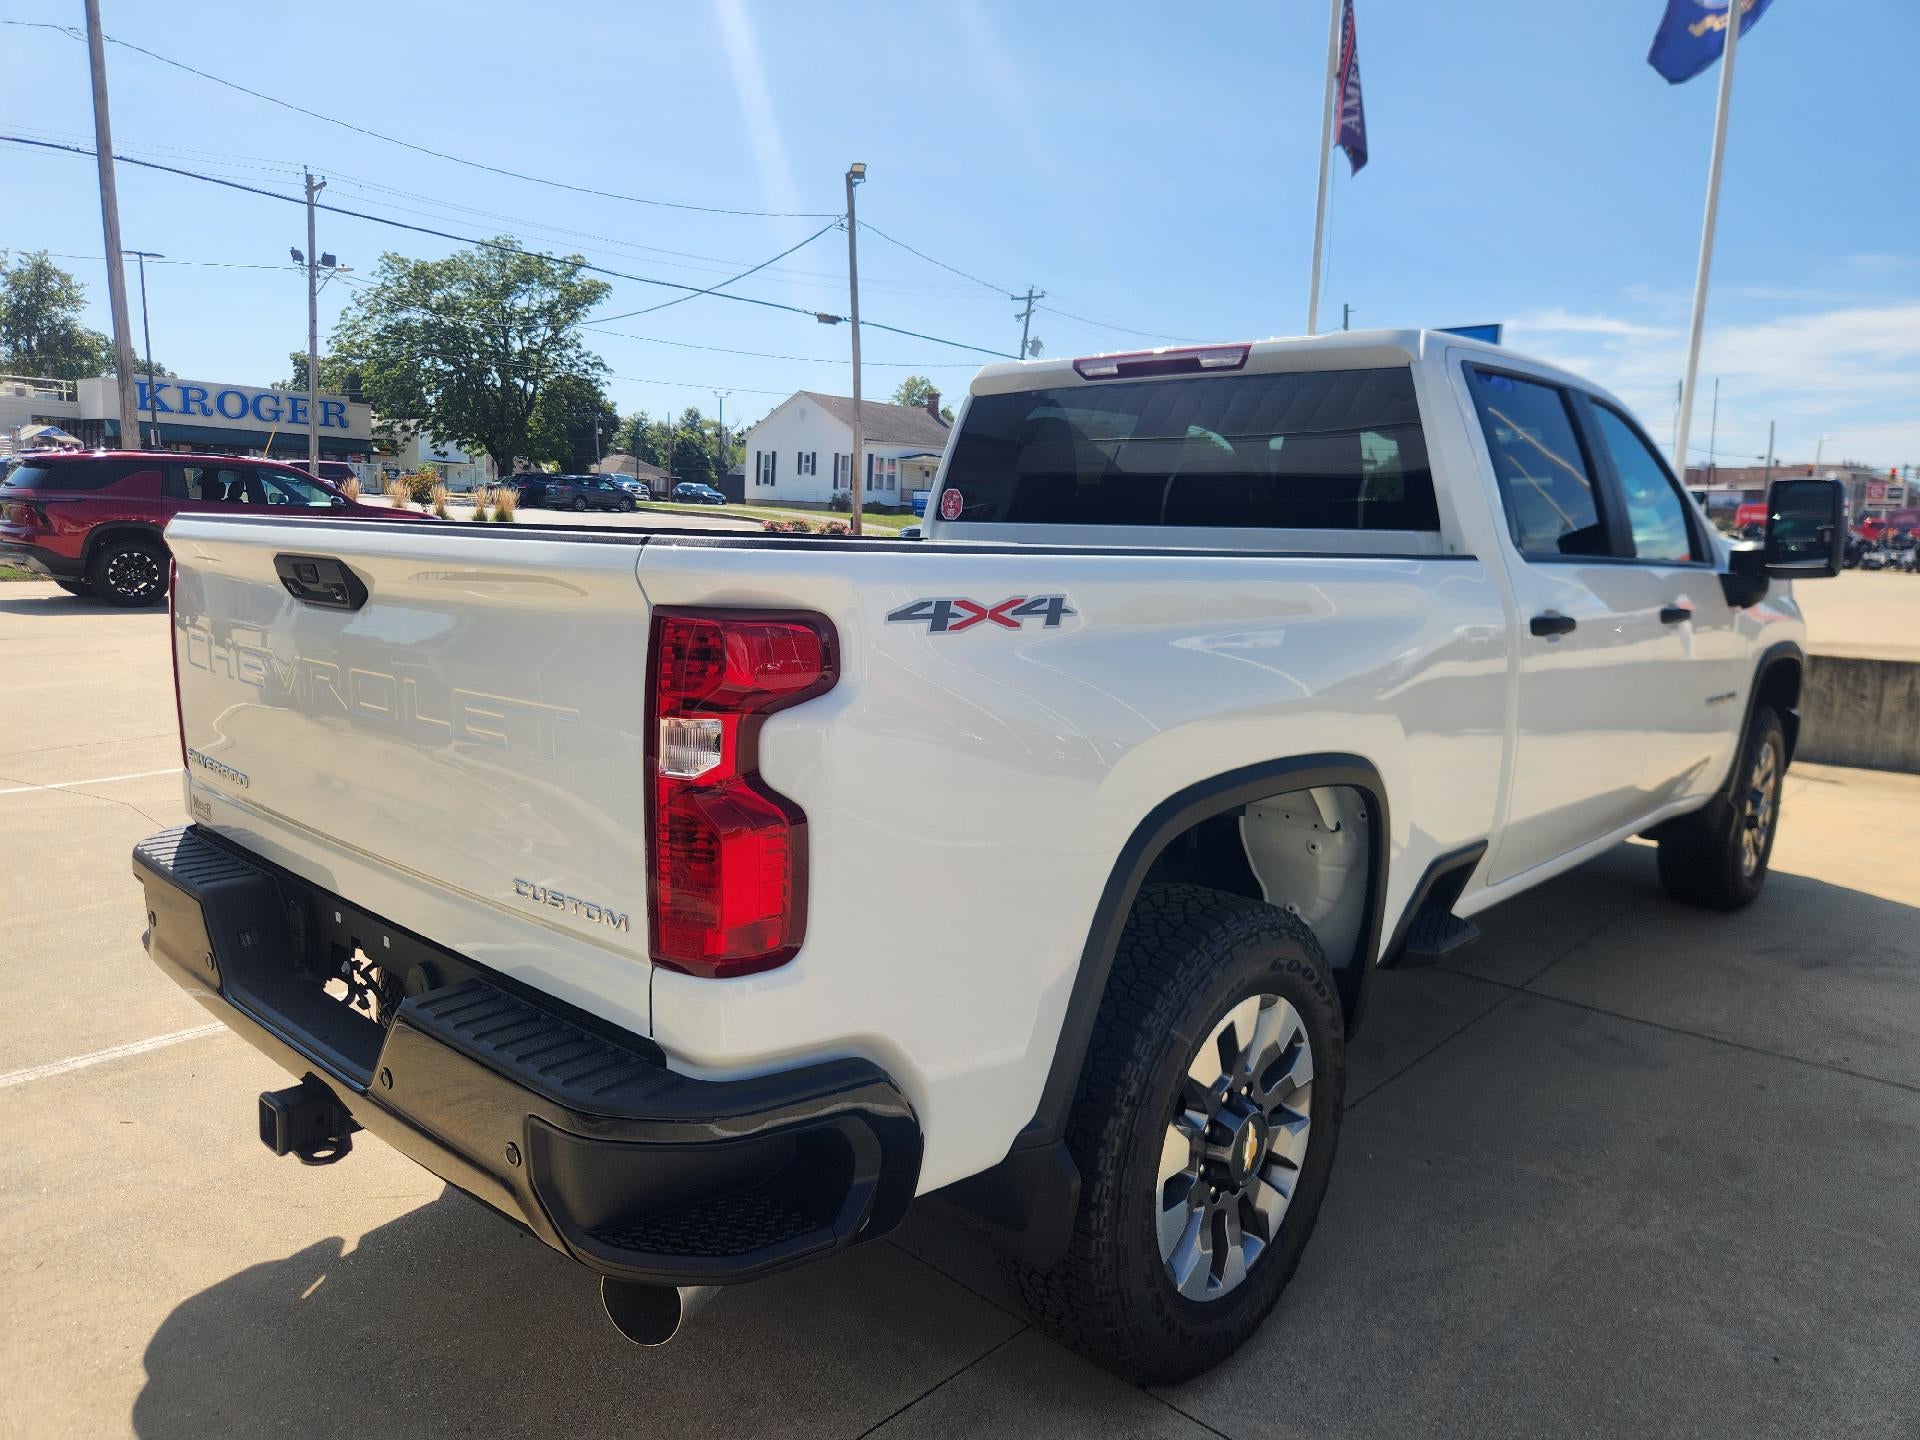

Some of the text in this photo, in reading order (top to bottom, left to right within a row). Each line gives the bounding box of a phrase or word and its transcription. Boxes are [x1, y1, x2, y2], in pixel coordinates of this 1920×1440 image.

[136, 381, 350, 428] KROGER
[186, 626, 581, 760] CHEVROLET
[512, 878, 630, 933] CUSTOM
